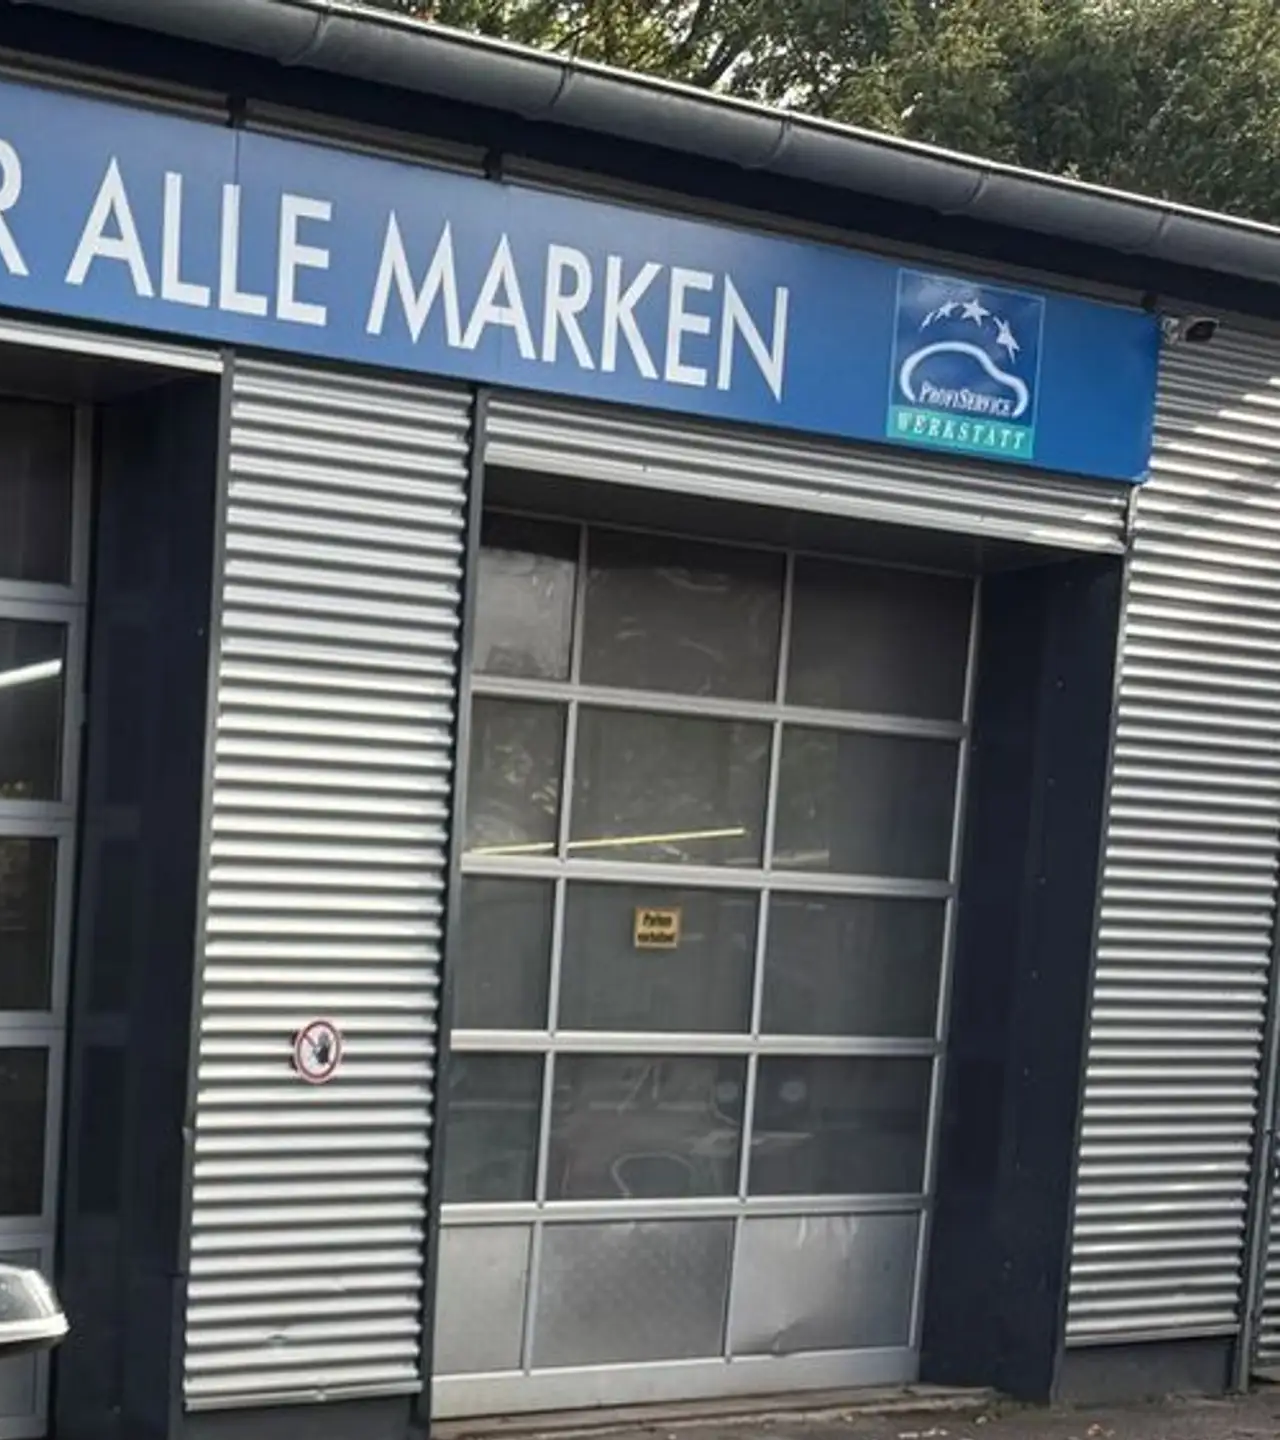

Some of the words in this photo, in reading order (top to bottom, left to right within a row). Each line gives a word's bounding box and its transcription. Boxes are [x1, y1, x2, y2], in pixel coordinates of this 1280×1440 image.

[65, 156, 332, 327] ALLE
[366, 210, 789, 403] MARKEN
[898, 412, 1026, 449] WERKSTATT
